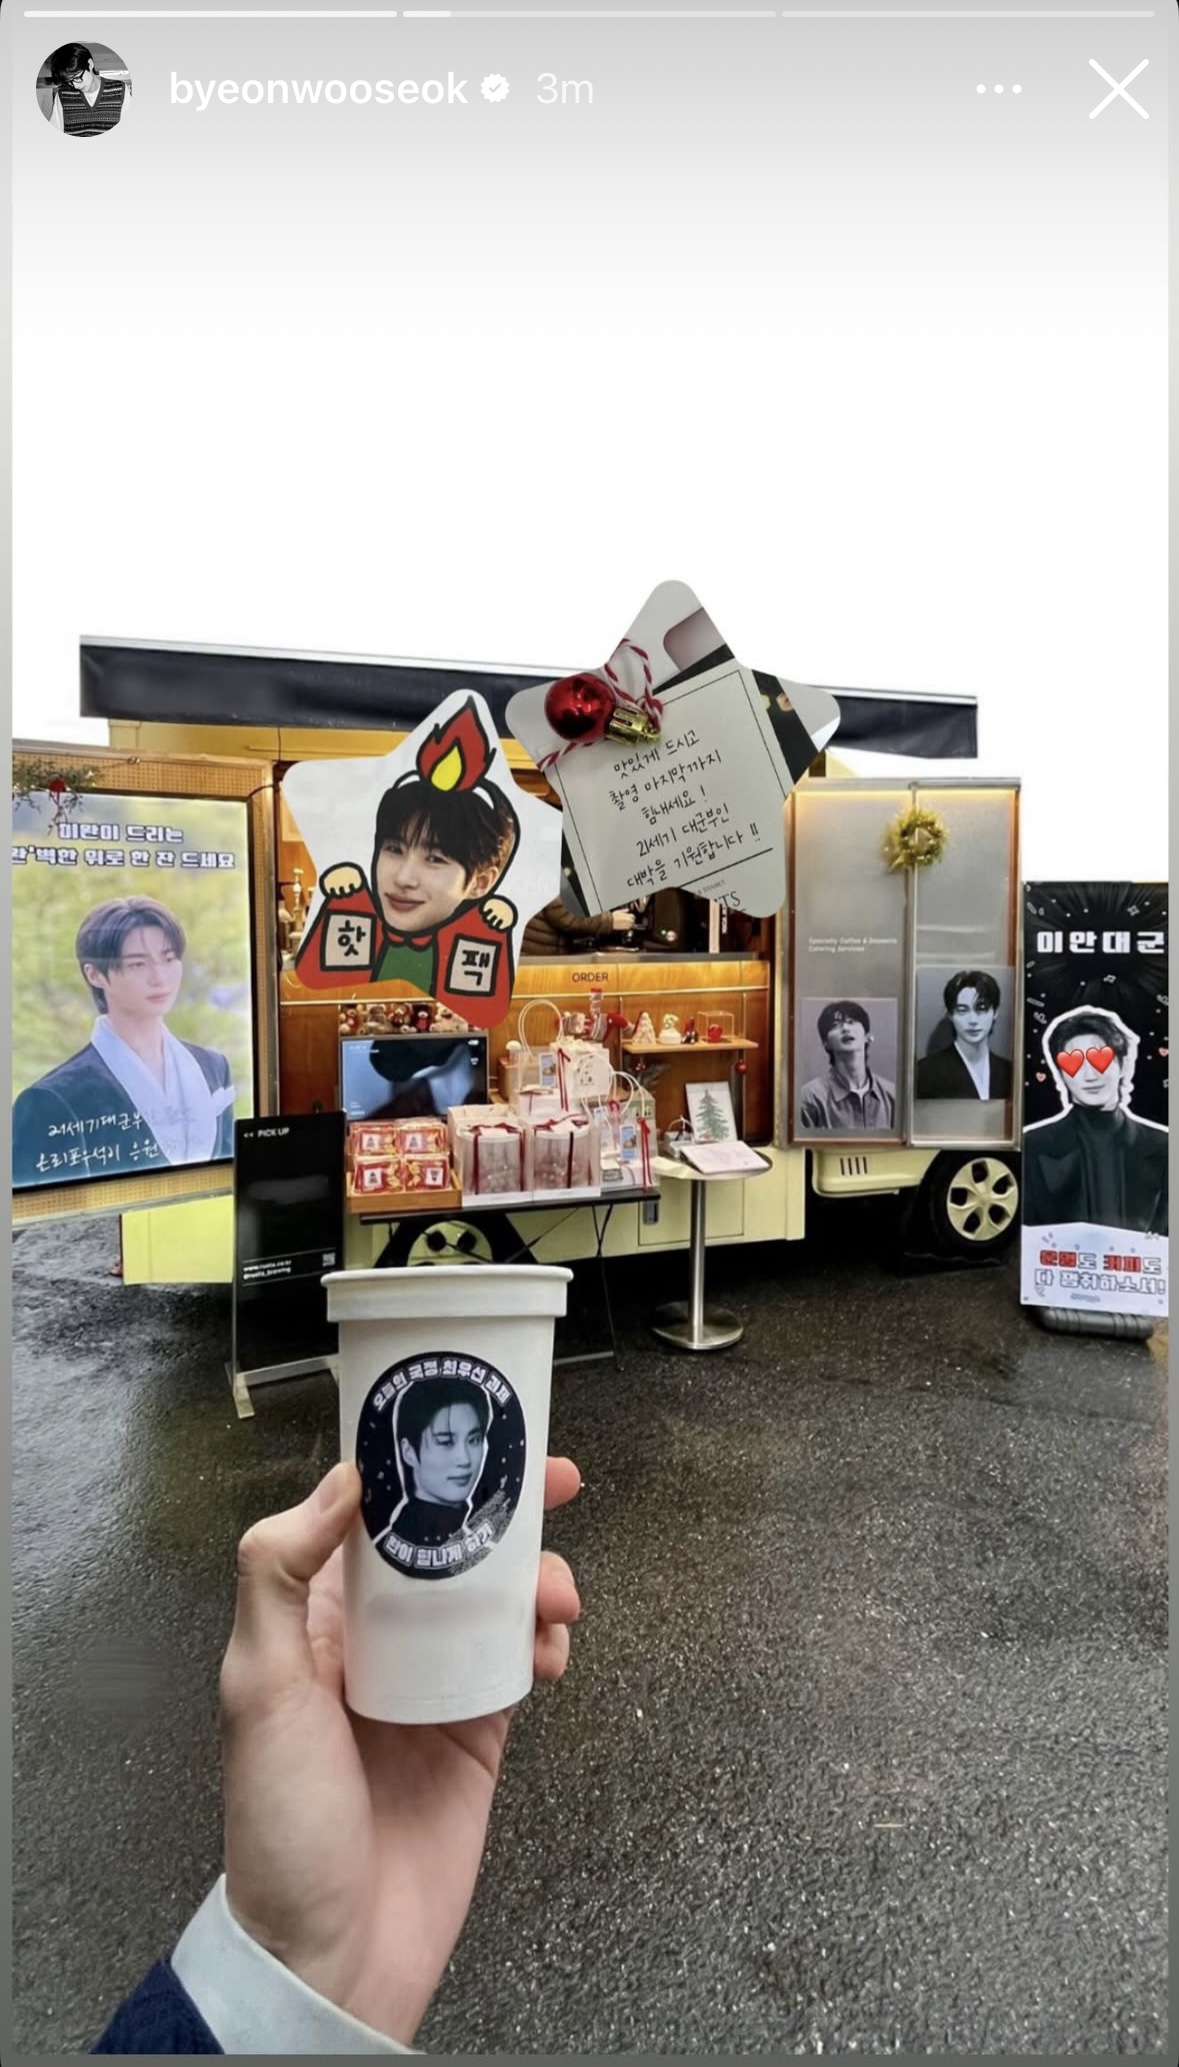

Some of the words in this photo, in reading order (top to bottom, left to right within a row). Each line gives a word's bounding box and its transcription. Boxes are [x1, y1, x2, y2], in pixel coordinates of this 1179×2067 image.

[614, 748, 661, 778] 맛있게
[665, 730, 699, 756] 드시고
[609, 784, 639, 811] 촬영
[644, 749, 722, 792] 마지막까지
[641, 790, 696, 825] 힘내세요
[126, 824, 184, 843] 드리는
[636, 827, 677, 857] 21세기
[682, 803, 729, 834] 대군부인
[84, 848, 125, 867] 위로
[130, 850, 151, 867] 한
[156, 850, 176, 867] 잔
[181, 851, 235, 868] 드세요
[627, 859, 667, 888] 대박을
[674, 831, 743, 869] 기원합니다
[337, 919, 367, 958] 핫
[460, 949, 490, 986] 팩
[572, 971, 609, 983] ORDER
[257, 1128, 276, 1138] PICK
[278, 1127, 290, 1136] UP
[1034, 1268, 1054, 1287] 다
[1103, 1254, 1161, 1275] 커피도
[373, 1371, 408, 1412] 오늘의
[464, 1522, 494, 1552] 하기
